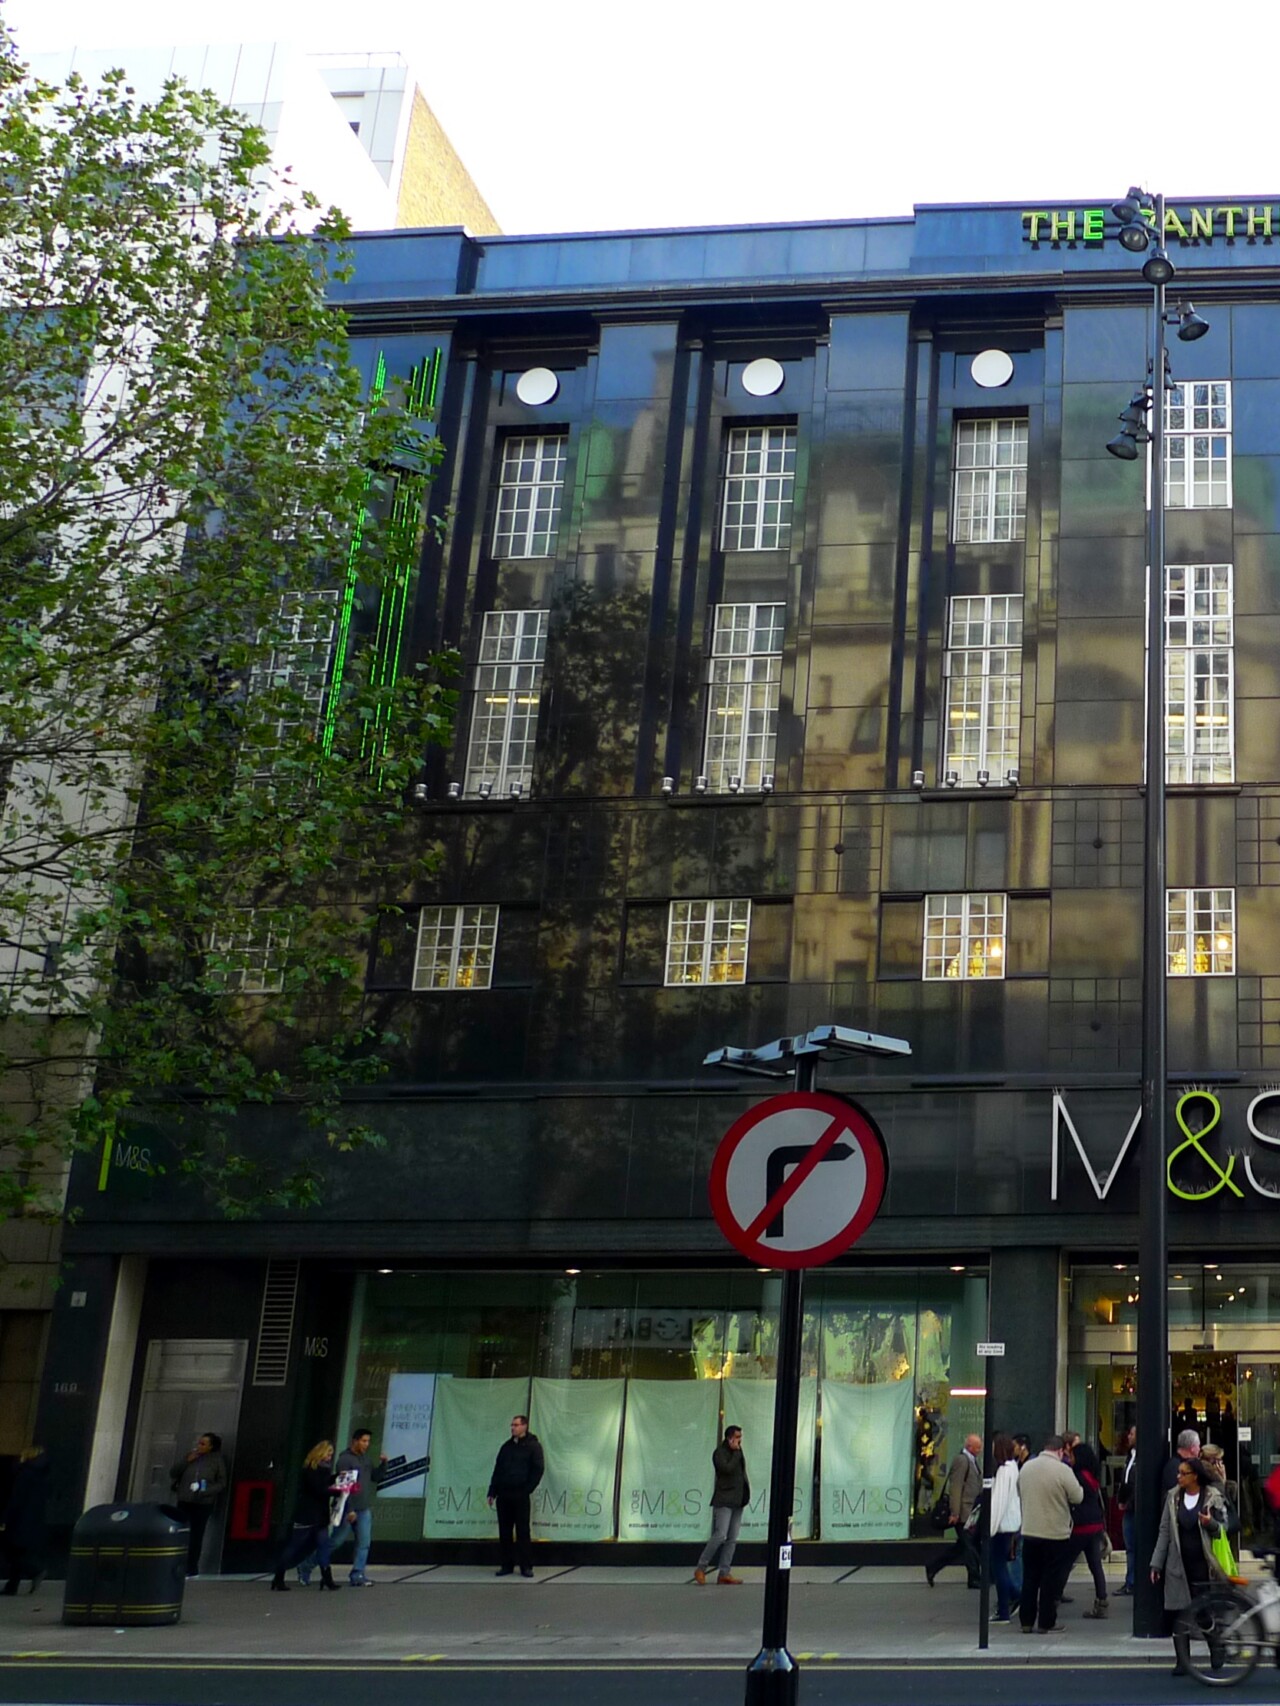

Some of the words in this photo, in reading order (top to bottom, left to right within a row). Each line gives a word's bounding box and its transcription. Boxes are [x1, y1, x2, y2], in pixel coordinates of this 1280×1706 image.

[1022, 209, 1104, 241] THE
[114, 1142, 152, 1172] M&S
[304, 1336, 329, 1358] M&S
[447, 1485, 497, 1512] M&
[542, 1488, 603, 1516] M&S
[640, 1488, 703, 1516] M&S
[841, 1487, 903, 1514] M&S
